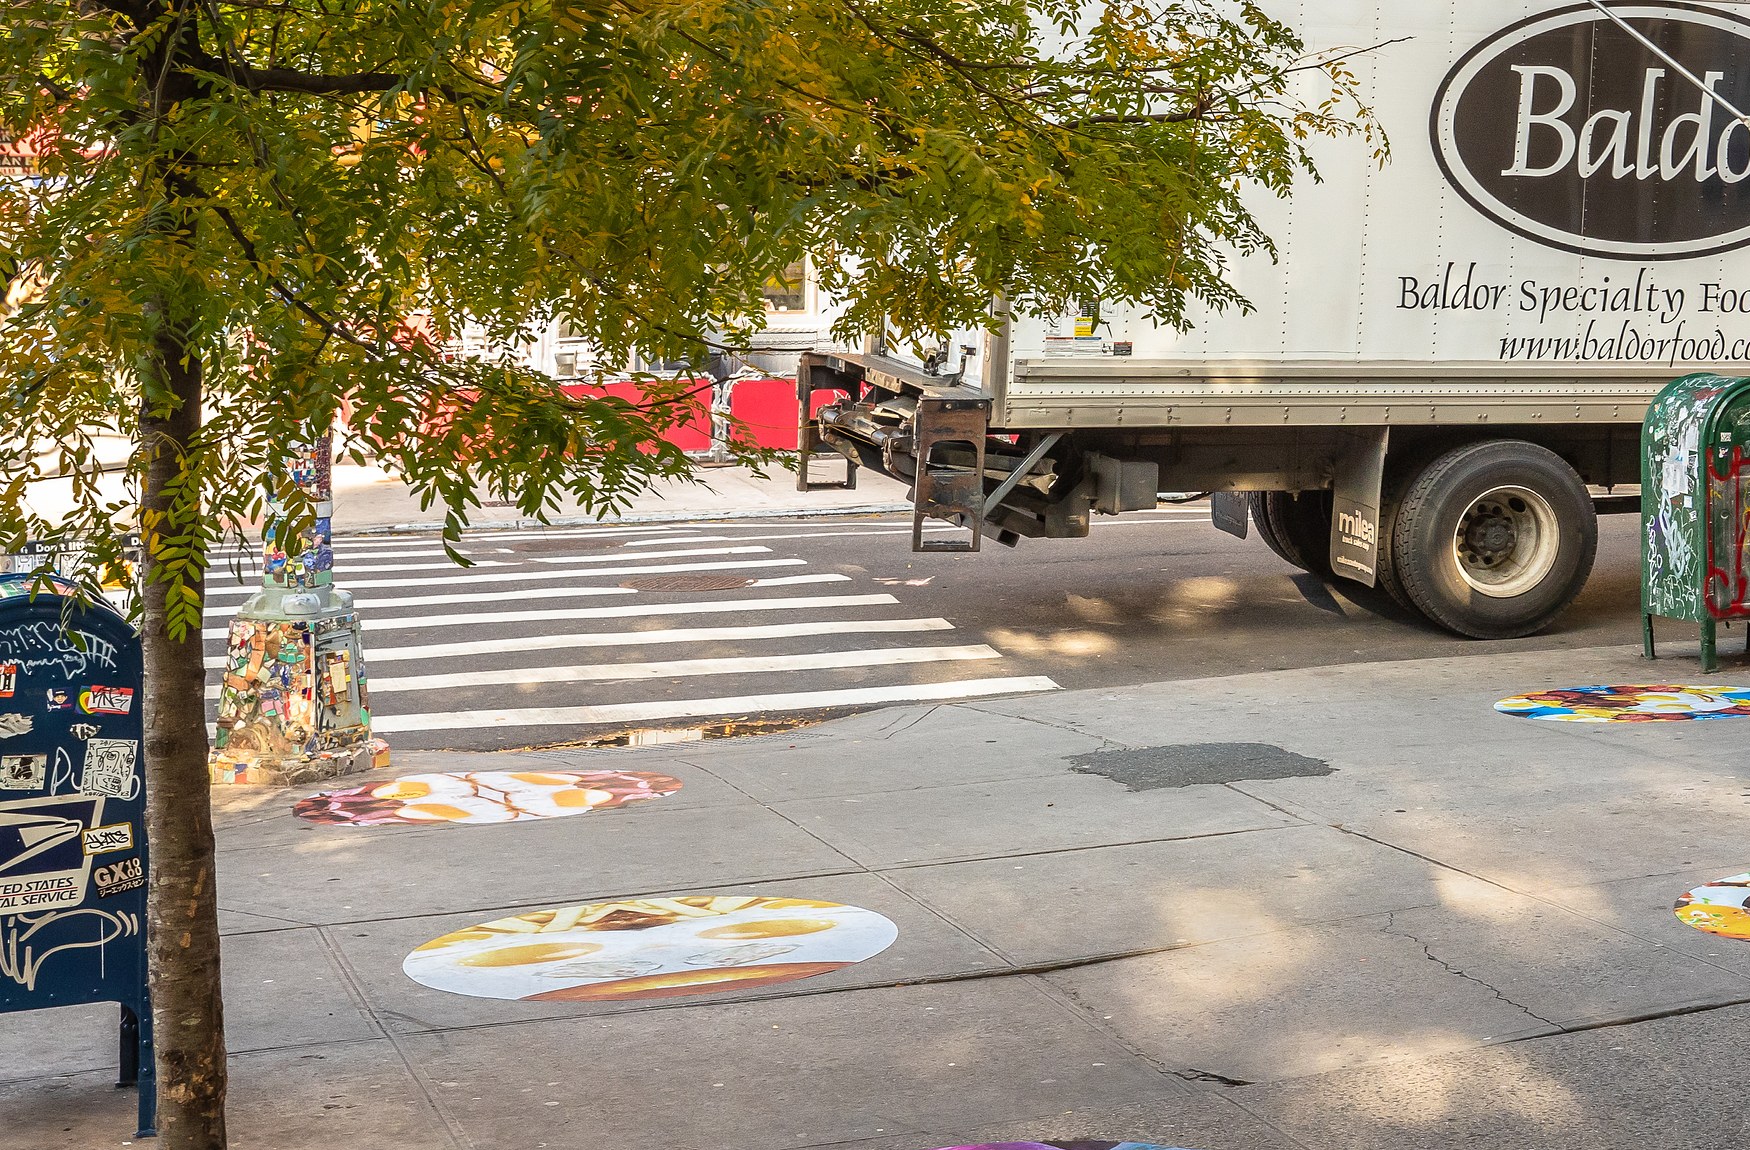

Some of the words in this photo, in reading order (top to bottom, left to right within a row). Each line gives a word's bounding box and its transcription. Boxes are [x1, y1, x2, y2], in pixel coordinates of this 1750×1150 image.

[1397, 262, 1508, 311] Baldor
[1519, 268, 1686, 324] Specialty
[1338, 509, 1375, 545] milea
[36, 541, 66, 553] Dont
[24, 876, 74, 892] STATES
